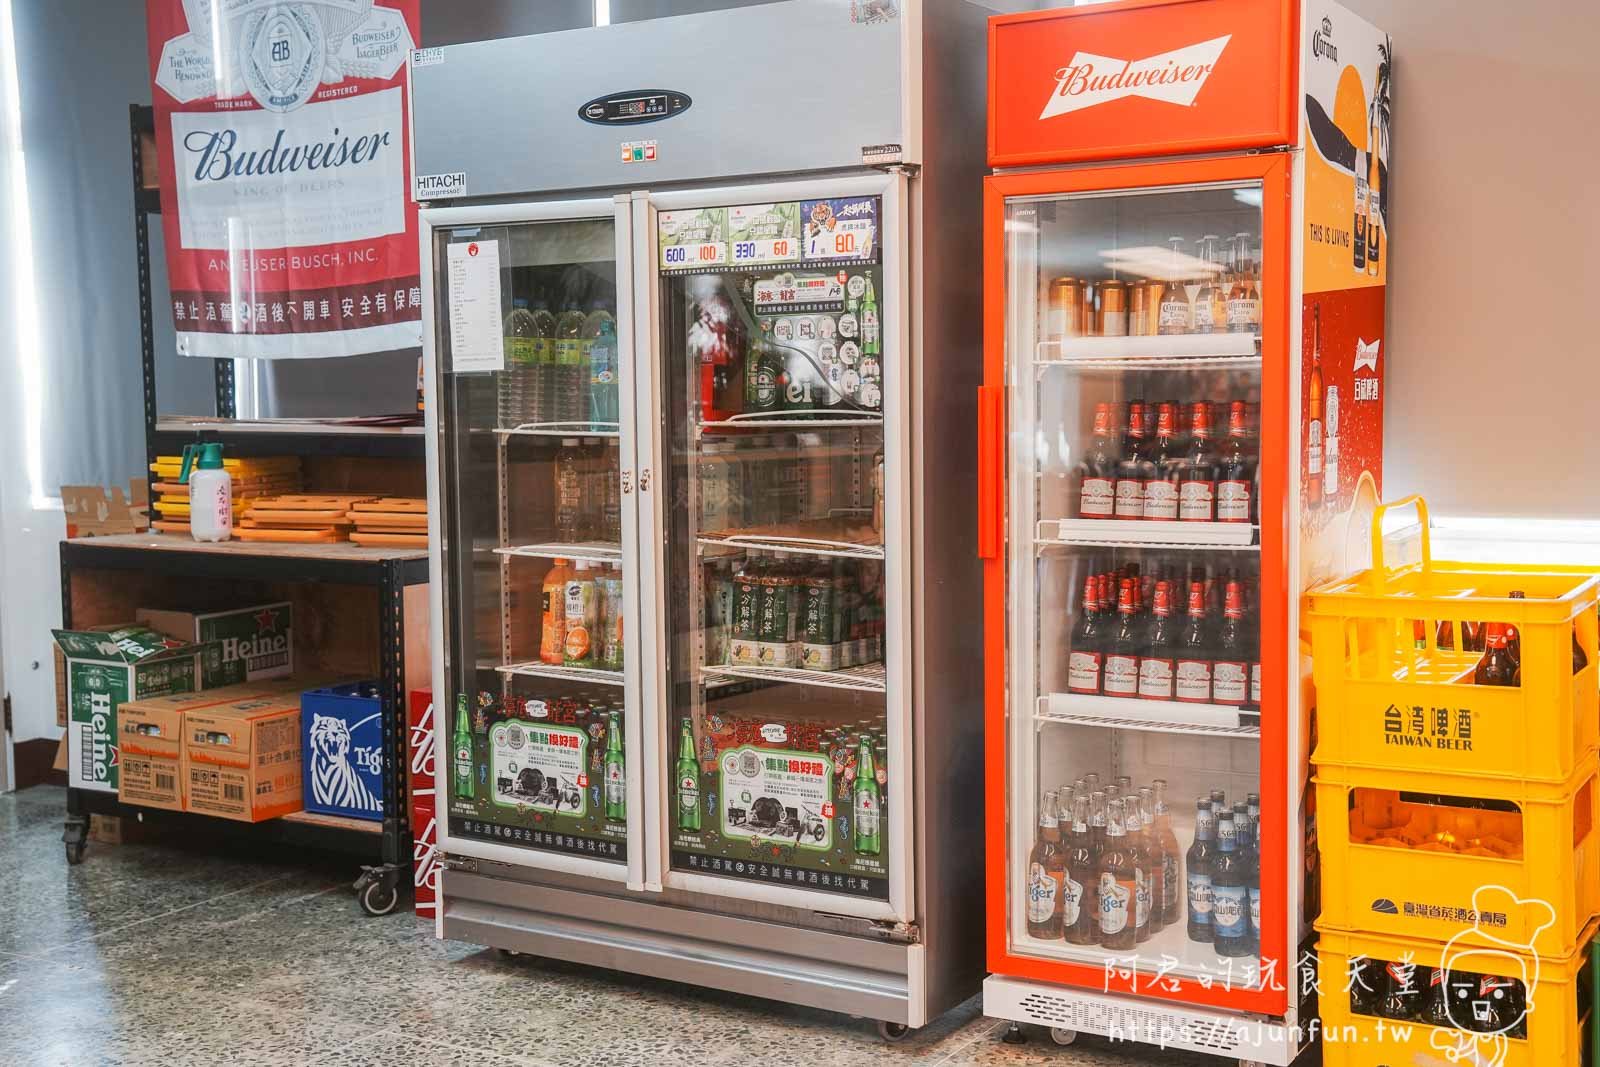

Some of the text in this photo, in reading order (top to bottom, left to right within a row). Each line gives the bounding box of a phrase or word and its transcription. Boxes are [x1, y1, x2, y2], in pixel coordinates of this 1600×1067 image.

[352, 29, 398, 45] BUDWEISER
[1313, 29, 1337, 62] Corona
[272, 40, 290, 61] AB
[170, 56, 182, 67] THE
[1054, 59, 1213, 97] Budweiser
[318, 86, 358, 99] REGISTERED
[184, 127, 390, 181] Budweiser
[418, 174, 464, 189] HITACHI
[421, 189, 460, 197] Compressor
[811, 240, 816, 254] 1
[836, 233, 854, 253] 80
[1310, 223, 1349, 248] THIS IS LIVING
[349, 248, 379, 263] INC.
[666, 248, 685, 262] 600
[700, 246, 716, 260] 100
[736, 243, 755, 258] 330
[774, 241, 788, 256] 60
[741, 594, 750, 631] 分解茶
[764, 597, 774, 633] 分解茶
[808, 598, 819, 635] 分解茶
[1385, 733, 1473, 751] TAIWAN BEER
[766, 758, 823, 776] 集點換好禮
